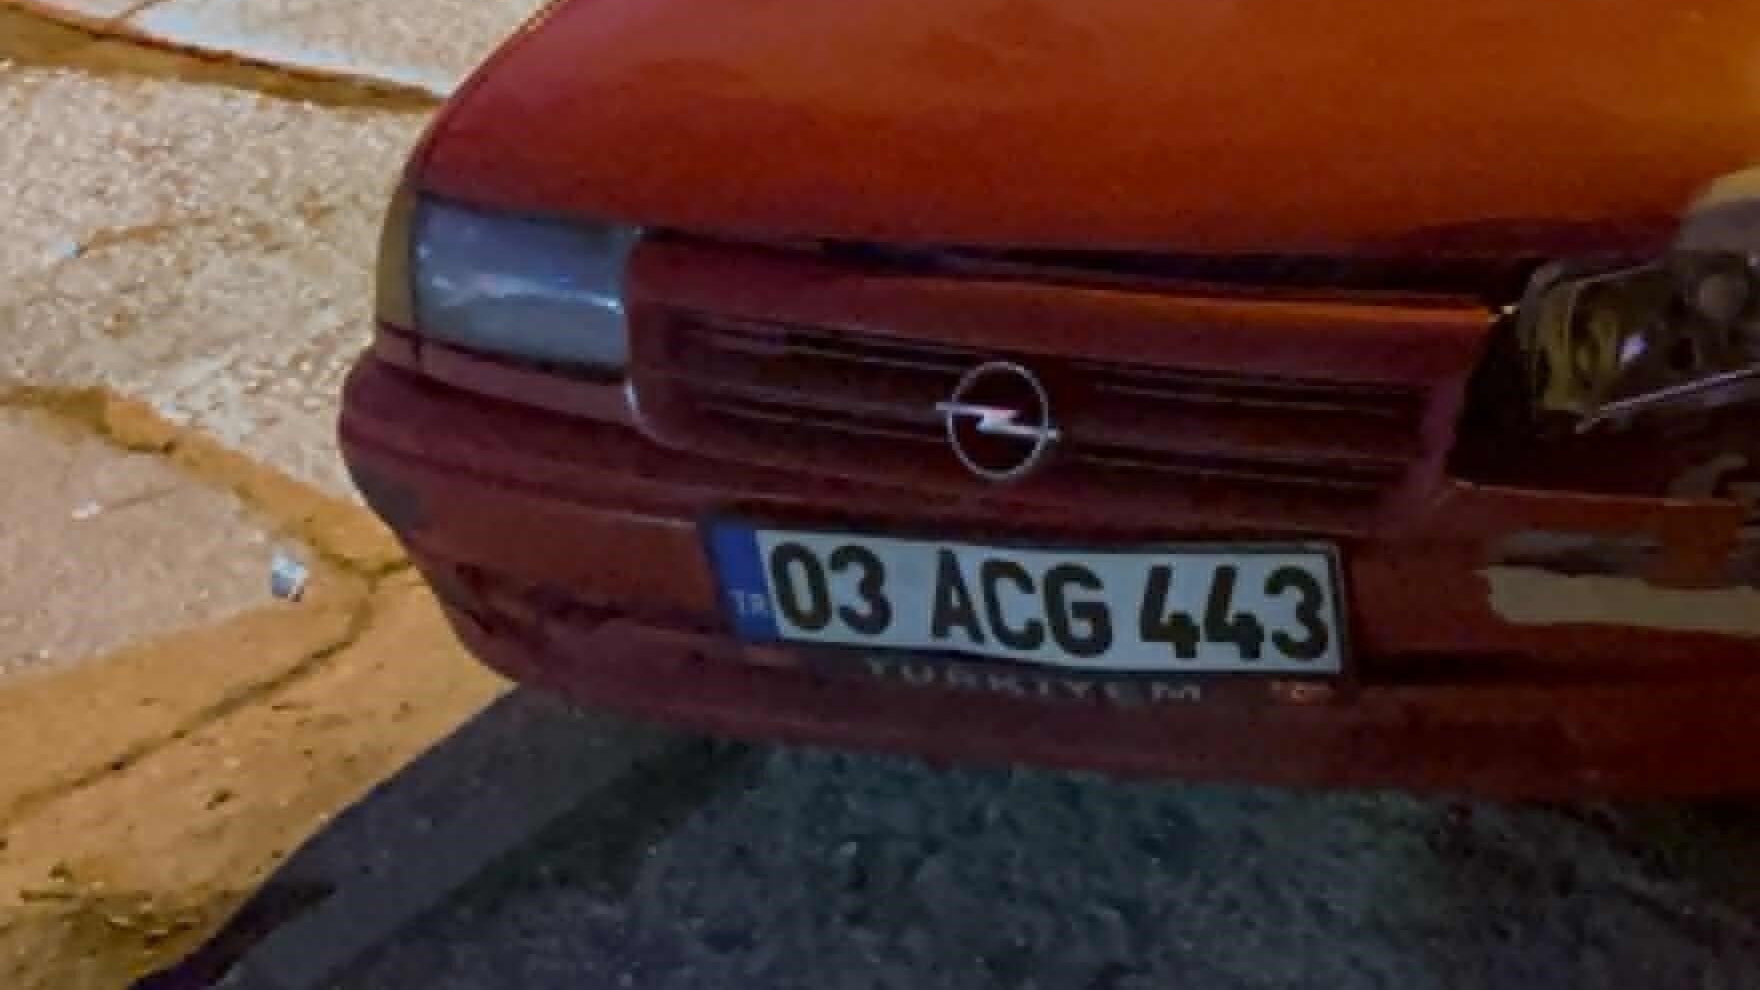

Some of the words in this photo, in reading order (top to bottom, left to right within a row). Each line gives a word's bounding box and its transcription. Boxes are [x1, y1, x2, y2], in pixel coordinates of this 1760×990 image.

[770, 541, 893, 635] 03
[931, 548, 1114, 658] ACG
[1138, 563, 1331, 663] 443
